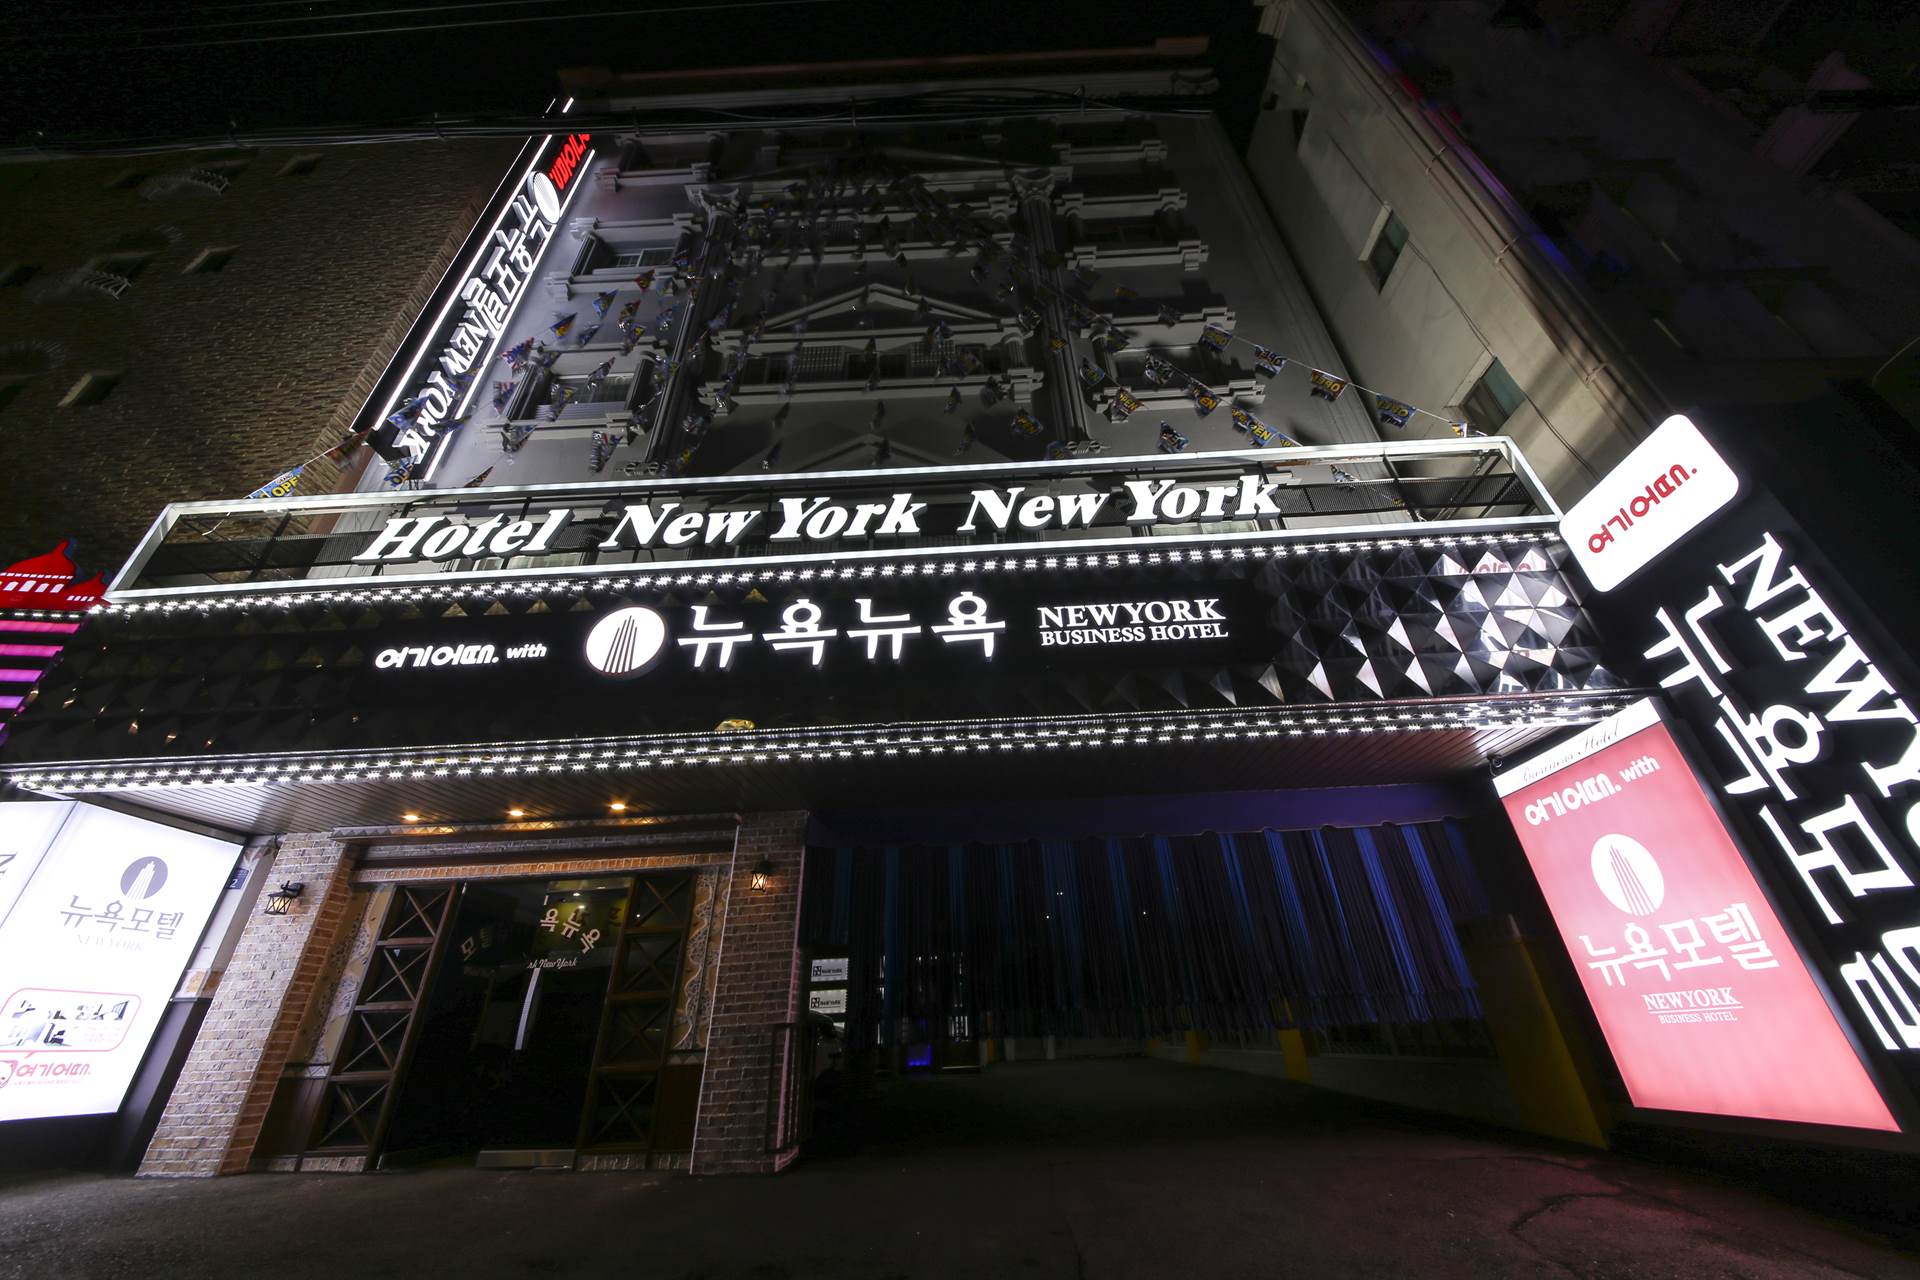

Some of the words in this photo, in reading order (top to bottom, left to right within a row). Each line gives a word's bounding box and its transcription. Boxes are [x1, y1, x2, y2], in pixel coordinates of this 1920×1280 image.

[461, 195, 550, 337] 뉴욕모텔
[353, 508, 573, 561] Hotel
[599, 502, 762, 549] New
[769, 492, 927, 539] York
[957, 486, 1110, 534] New
[1122, 474, 1282, 524] York
[1037, 598, 1226, 629] NEWYORK
[678, 591, 1006, 669] 뉴욕뉴욕
[1040, 627, 1146, 646] BUSINESS
[1149, 622, 1229, 641] HOTEL
[506, 643, 547, 659] with
[1619, 755, 1661, 783] with
[60, 894, 184, 941] 뉴욕모텔
[1578, 902, 1780, 987] 뉴욕모텔
[1641, 987, 1741, 1010] NEWYORK
[1658, 1013, 1702, 1024] BUSINESS
[1702, 1010, 1738, 1022] HOTEL
